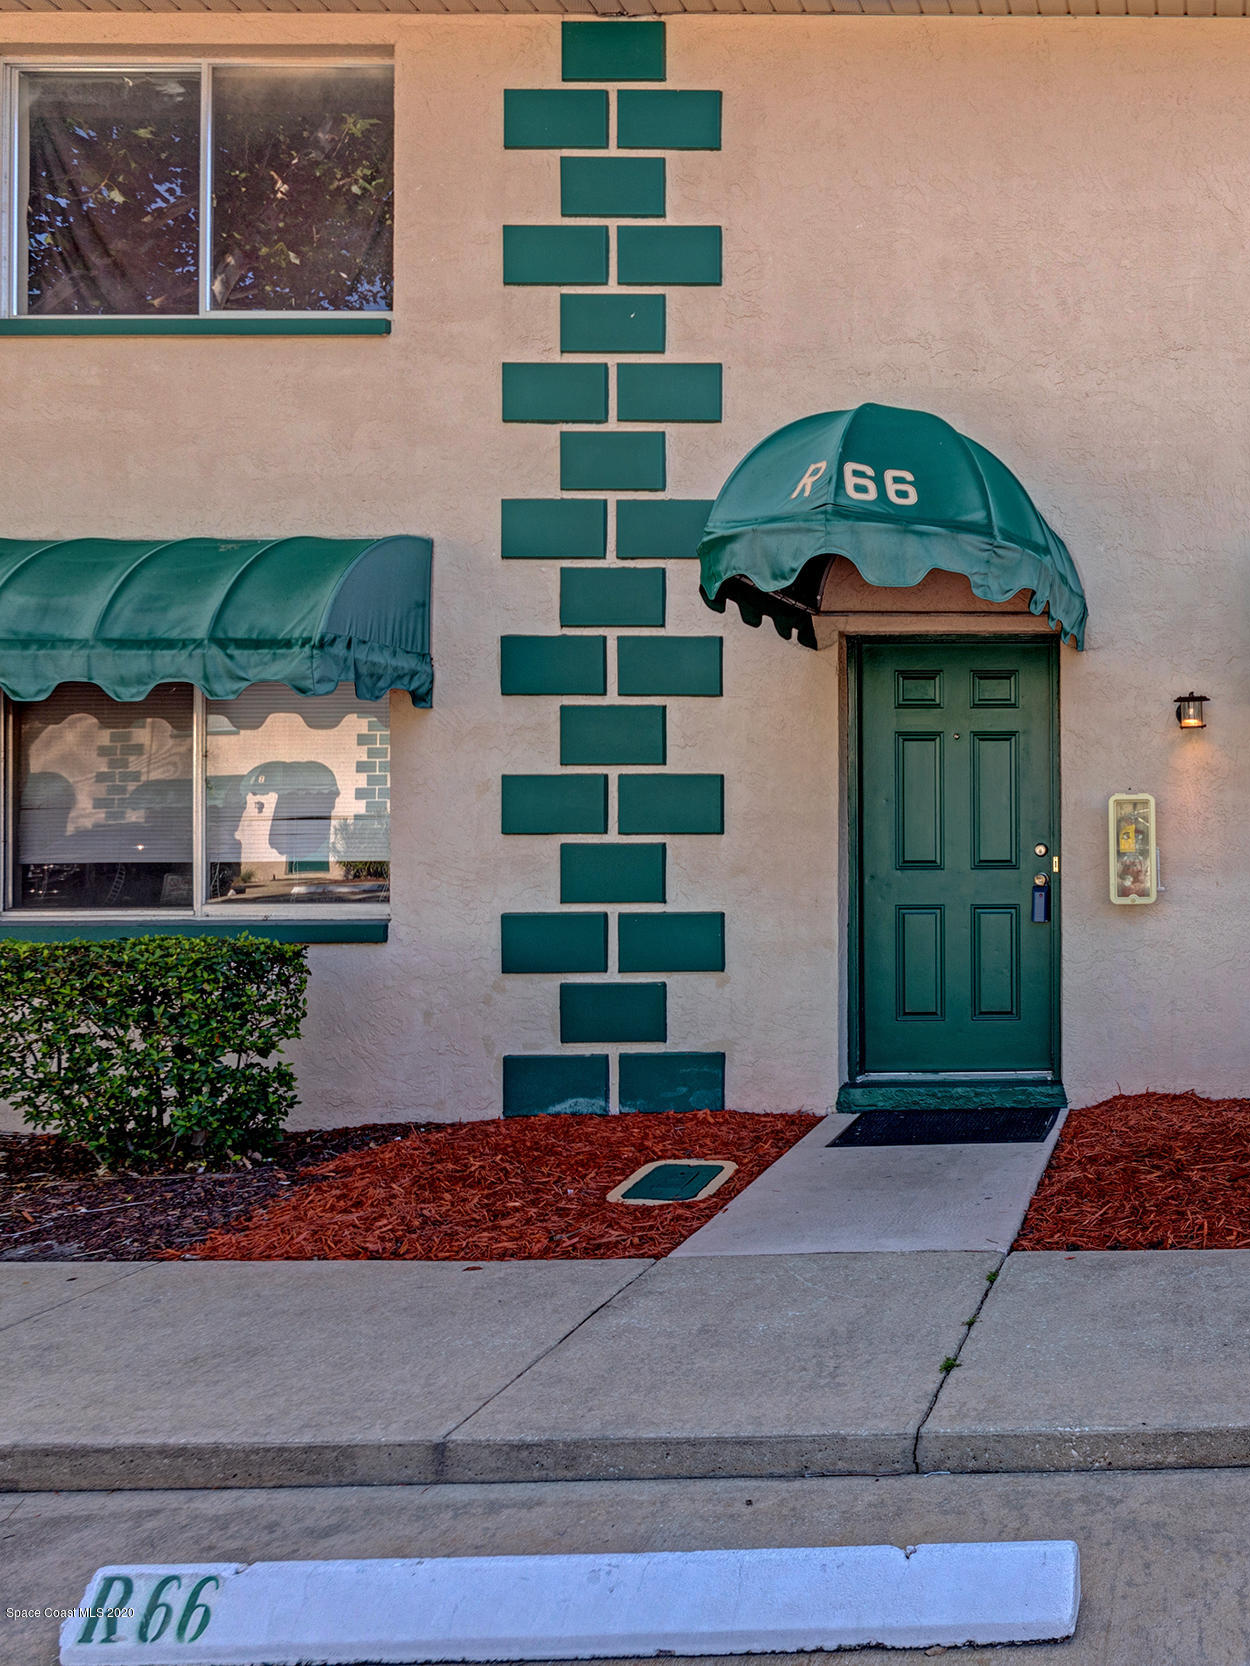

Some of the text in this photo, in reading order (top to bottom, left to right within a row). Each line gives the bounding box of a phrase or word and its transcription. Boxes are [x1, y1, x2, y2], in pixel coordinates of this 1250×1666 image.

[791, 461, 918, 505] R 66
[76, 1575, 219, 1643] R66
